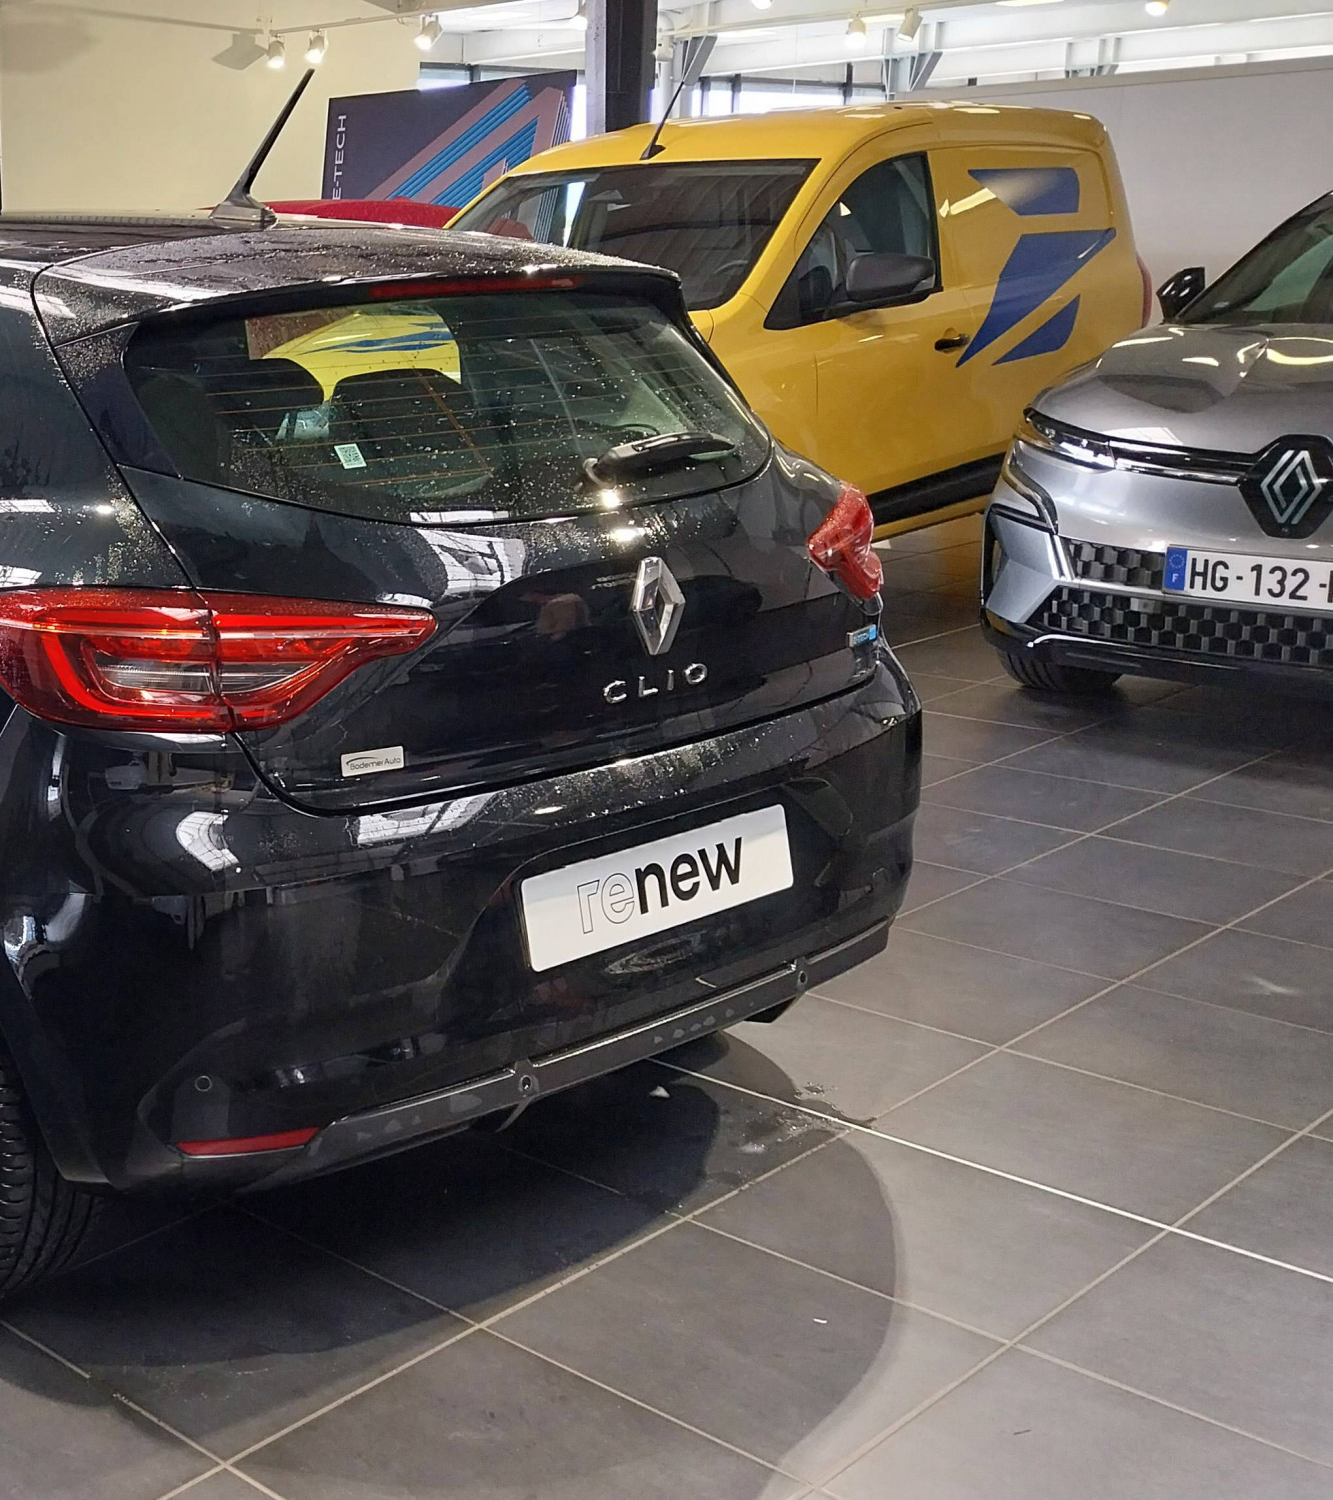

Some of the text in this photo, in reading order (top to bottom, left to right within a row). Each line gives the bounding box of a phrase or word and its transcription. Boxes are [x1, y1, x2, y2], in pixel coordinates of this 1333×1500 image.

[332, 115, 347, 200] E-TECH
[1172, 573, 1179, 583] F
[1189, 557, 1333, 603] HG-132-
[603, 663, 707, 704] CLIO
[577, 836, 742, 934] renew
